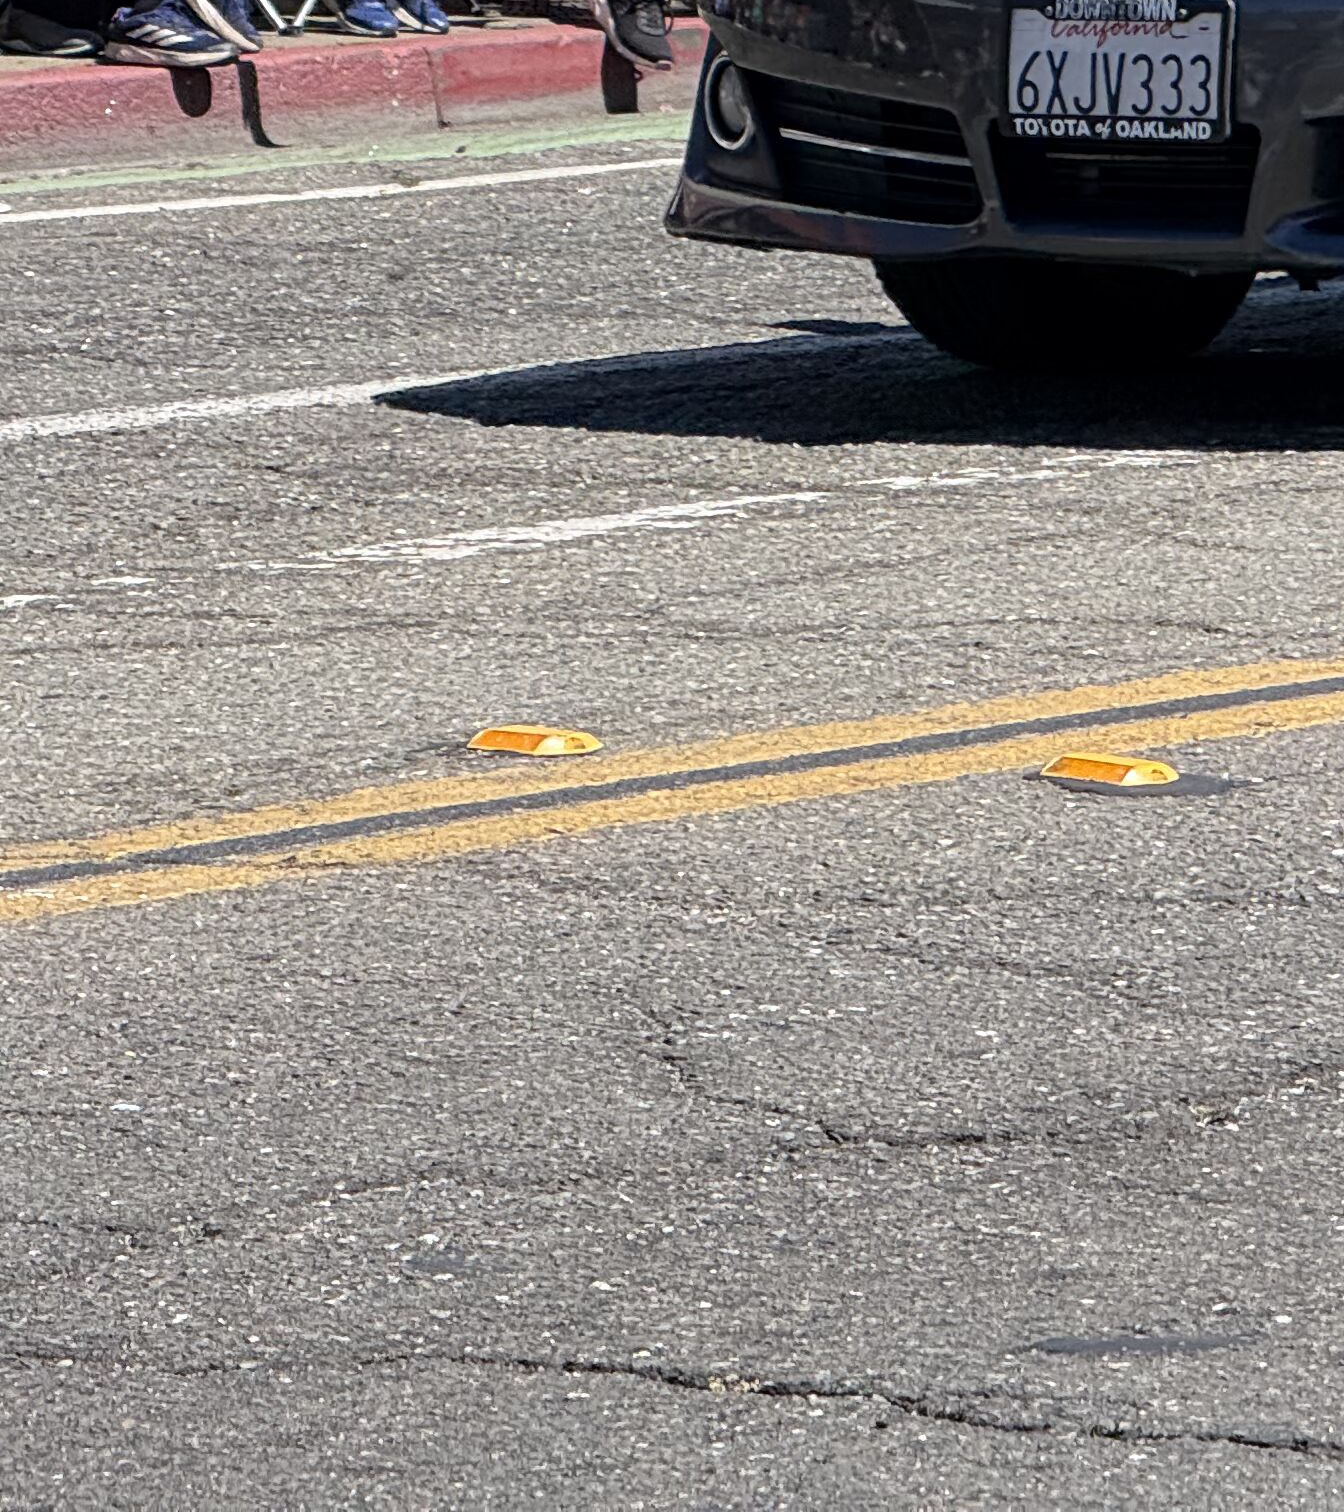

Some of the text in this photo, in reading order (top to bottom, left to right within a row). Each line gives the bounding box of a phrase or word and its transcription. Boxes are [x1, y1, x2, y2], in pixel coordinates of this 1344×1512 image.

[1051, 20, 1177, 48] California
[1016, 49, 1213, 117] 6XJV333
[1013, 117, 1092, 138] TOYOTA
[1115, 119, 1212, 141] OAKLAND
